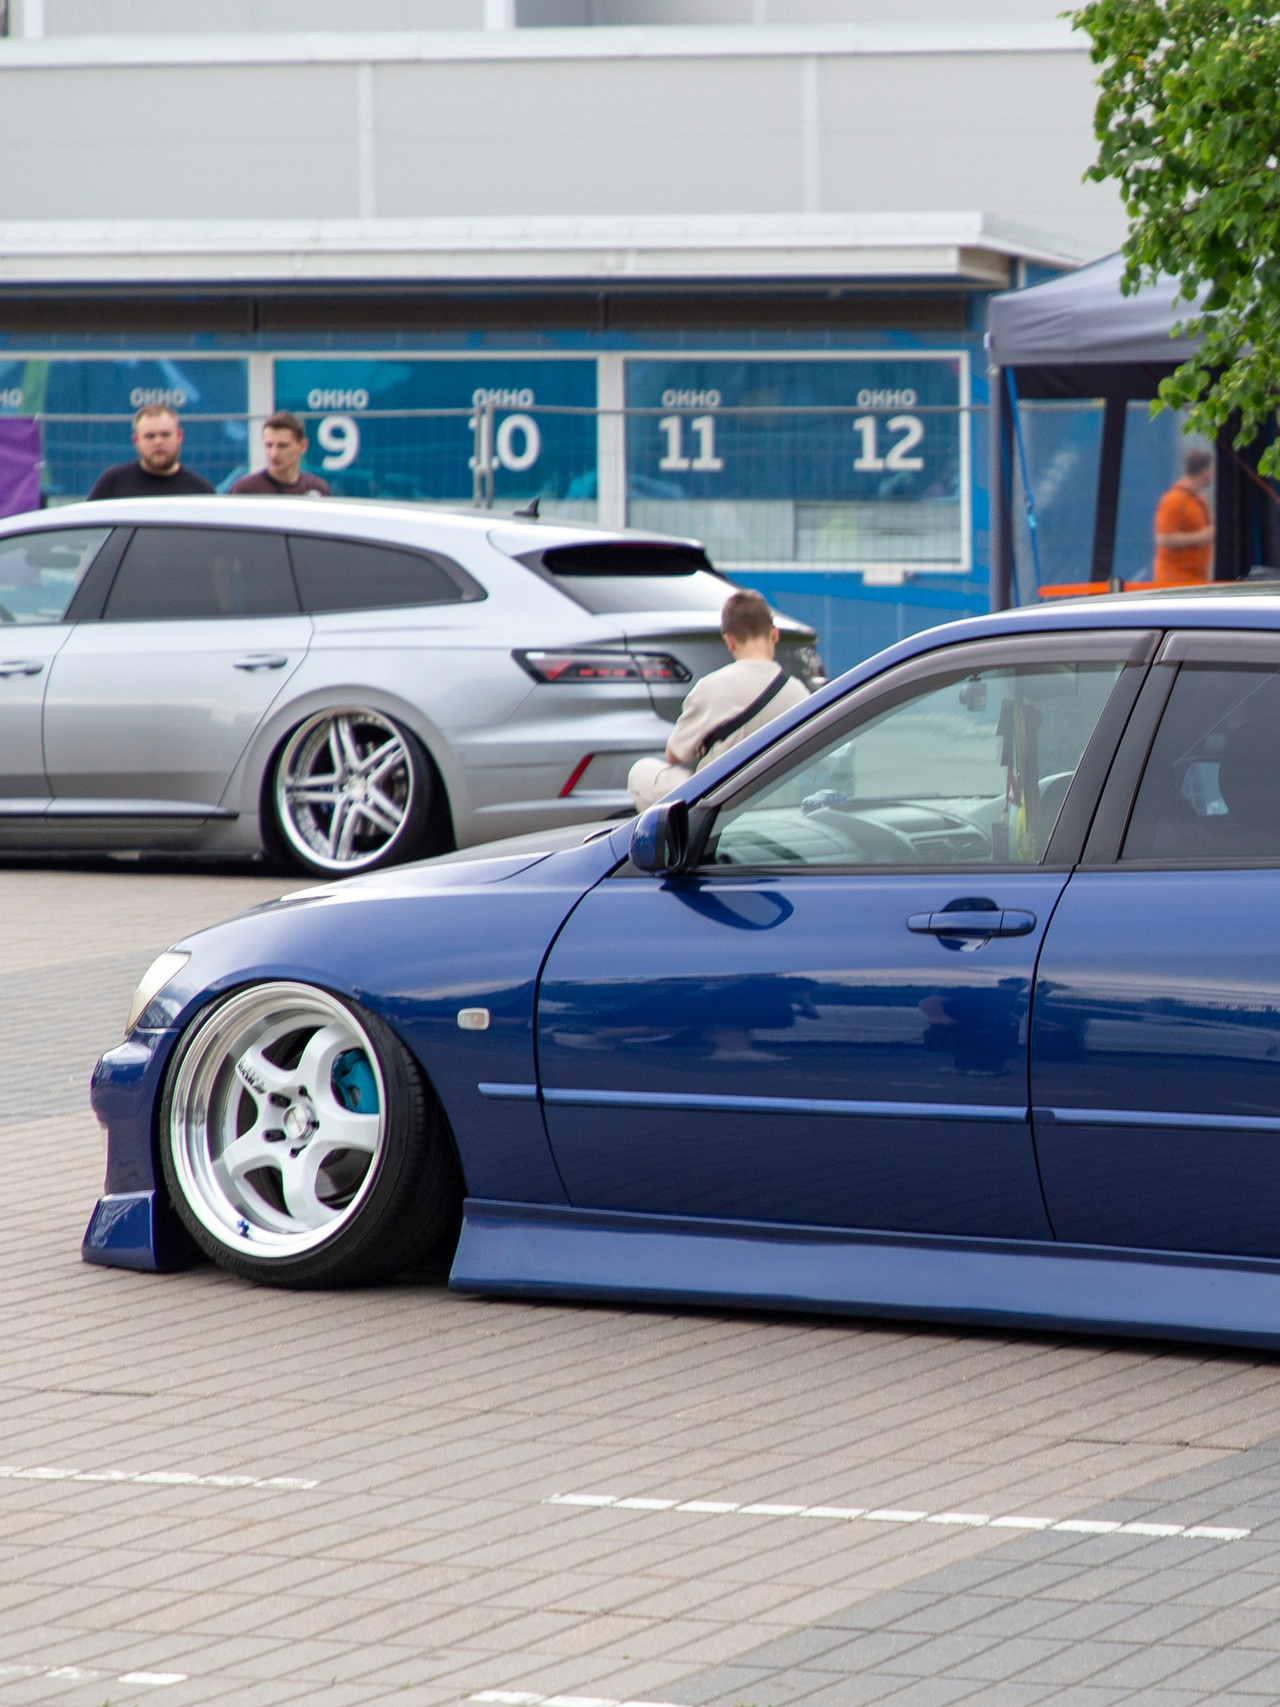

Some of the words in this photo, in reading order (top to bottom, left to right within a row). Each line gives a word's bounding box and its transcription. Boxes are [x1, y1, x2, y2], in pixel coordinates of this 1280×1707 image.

[0, 389, 24, 407] НО
[130, 388, 187, 407] ОКНО
[307, 388, 369, 410] ОКНО
[472, 388, 534, 407] ОКНО
[662, 389, 721, 408] ОКНО
[857, 389, 917, 408] ОКНО
[317, 415, 360, 471] 9
[468, 413, 541, 471] 10
[659, 415, 724, 471] 11
[853, 415, 924, 471] 12
